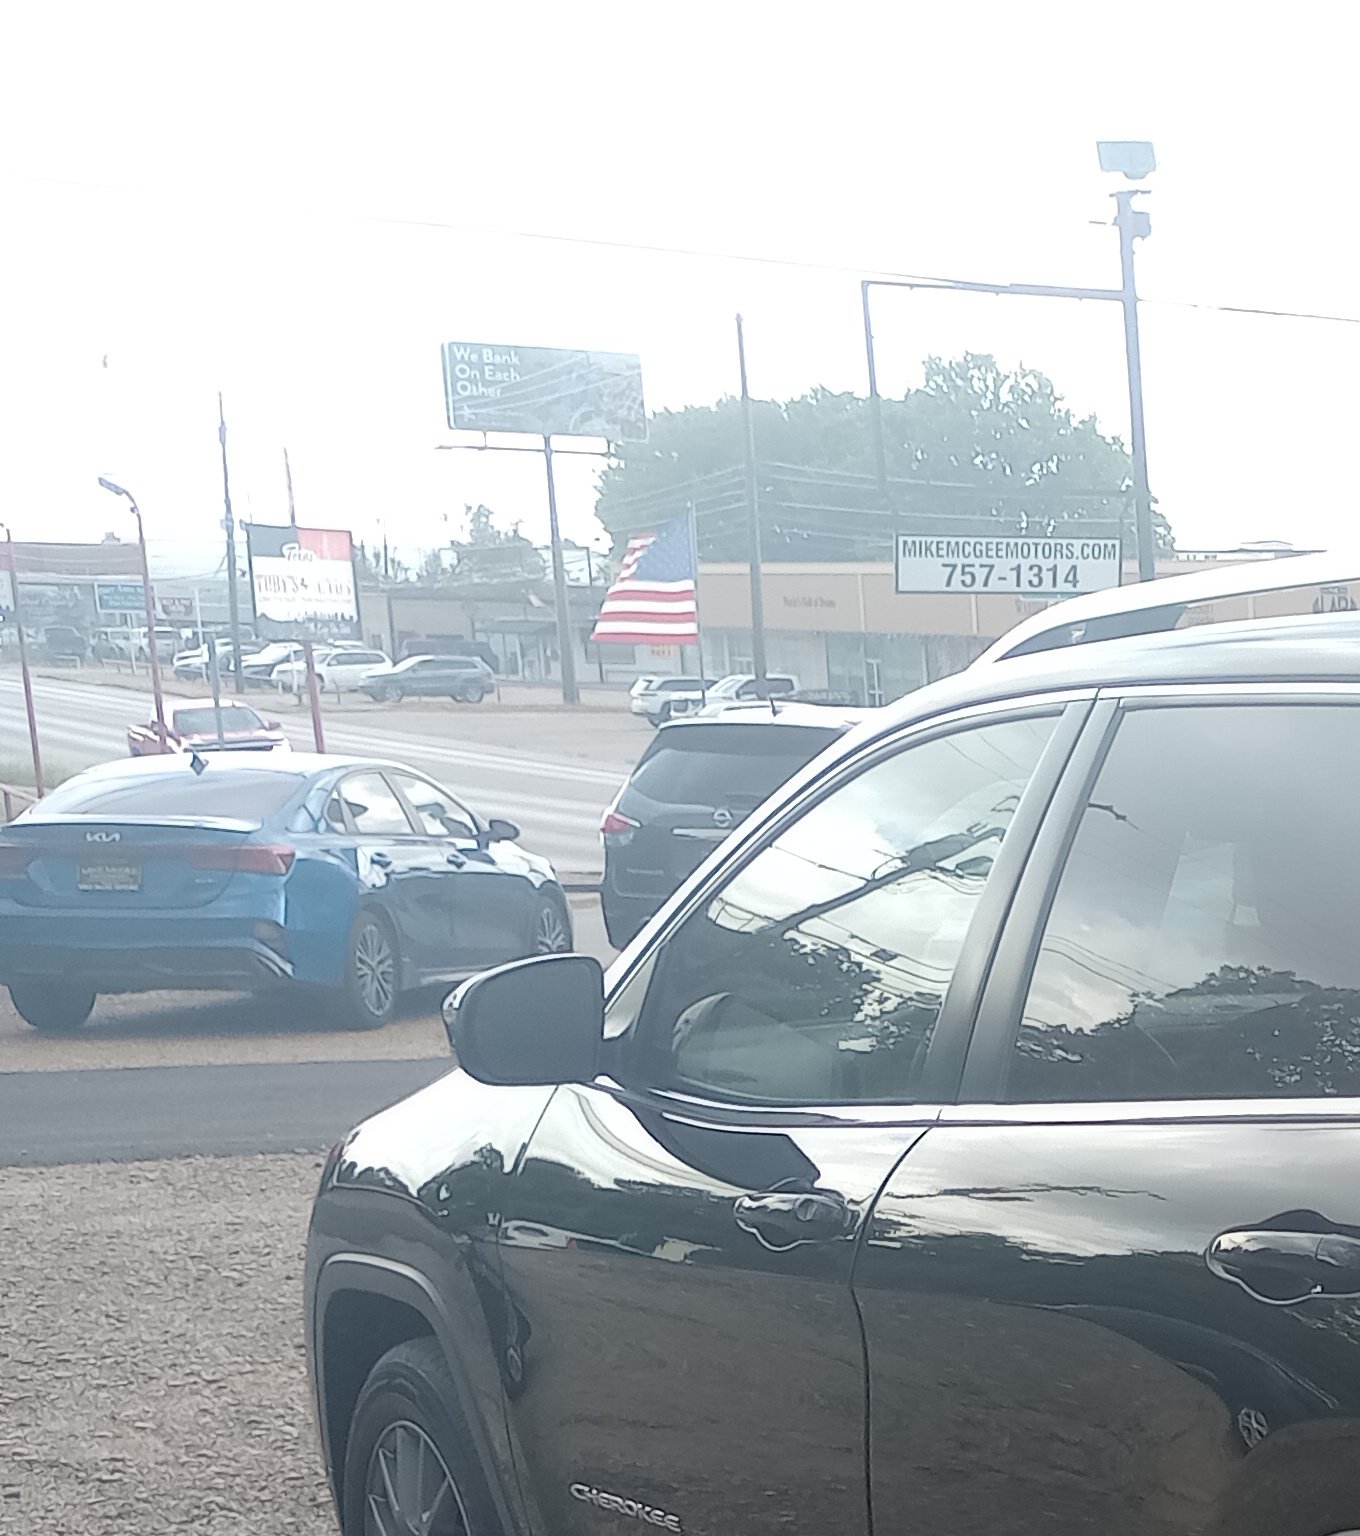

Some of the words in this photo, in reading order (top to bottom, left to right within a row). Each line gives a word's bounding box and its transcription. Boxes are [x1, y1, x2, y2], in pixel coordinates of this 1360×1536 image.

[453, 345, 478, 363] We
[482, 348, 520, 365] Bank
[455, 363, 480, 380] On
[484, 365, 520, 382] Each
[456, 380, 502, 397] Other
[902, 539, 1117, 561] MIKEMCGEEMOTORS.COM
[941, 563, 1080, 588] 757-1314
[570, 1483, 681, 1533] CHEROKEE
